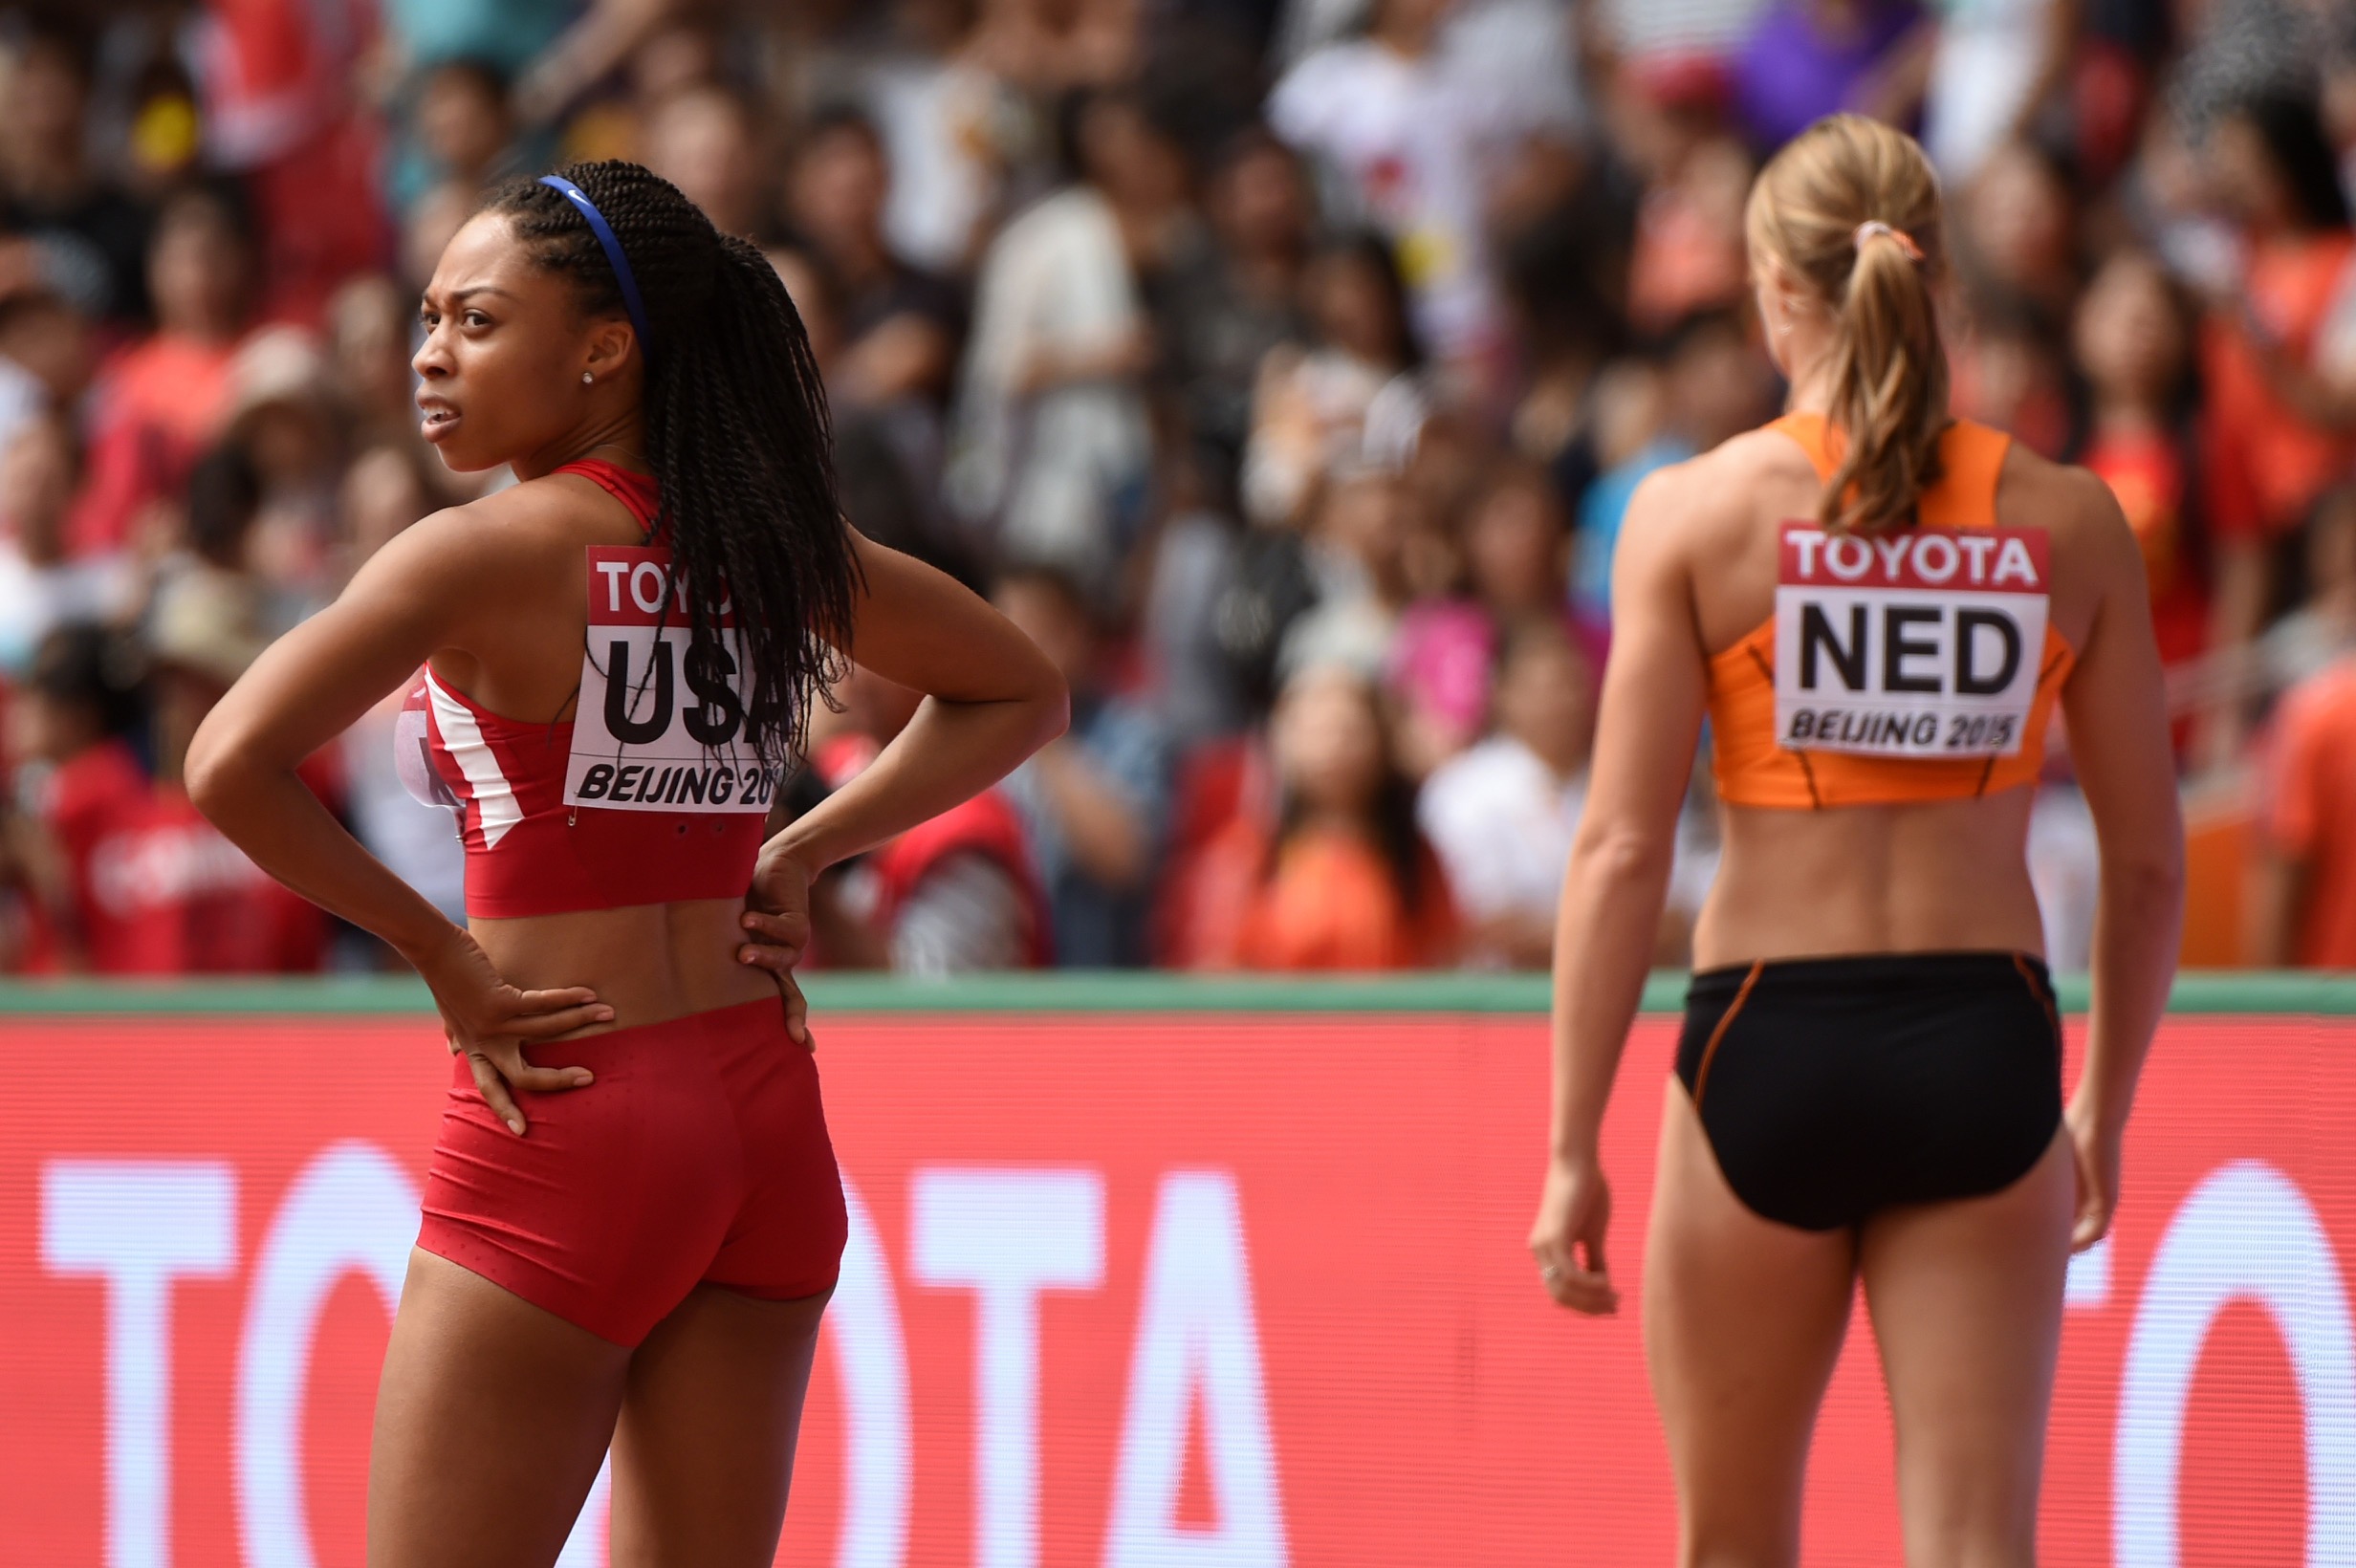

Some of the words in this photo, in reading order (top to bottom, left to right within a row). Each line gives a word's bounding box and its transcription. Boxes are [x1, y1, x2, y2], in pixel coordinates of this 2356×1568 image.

[1785, 529, 2040, 586] TOYOTA
[1799, 602, 2022, 696] NED
[1790, 708, 1938, 748] BEIJING
[578, 763, 734, 805] BEIJING
